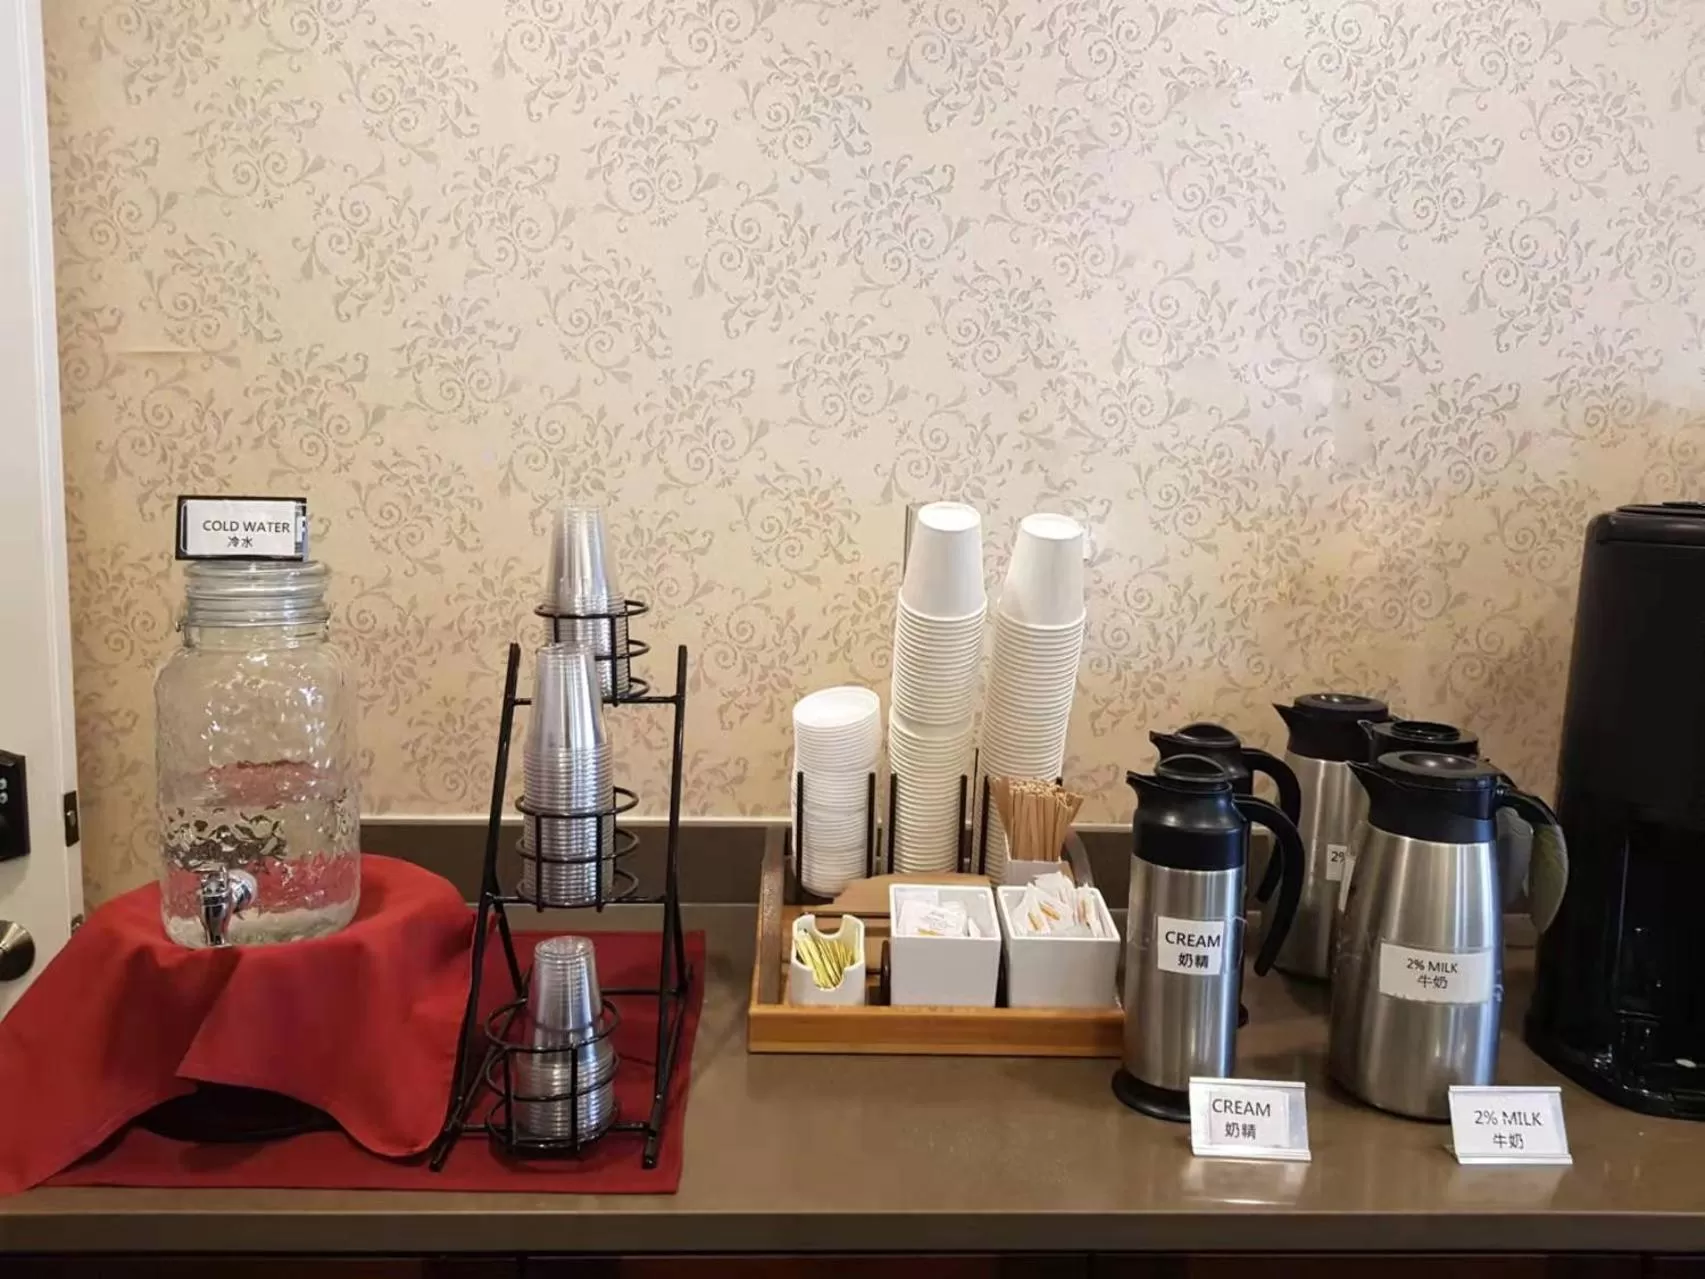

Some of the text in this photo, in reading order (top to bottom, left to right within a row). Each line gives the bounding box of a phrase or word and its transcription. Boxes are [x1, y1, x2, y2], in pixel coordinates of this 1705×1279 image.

[203, 520, 290, 533] COLD WATER
[227, 536, 253, 548] 冷水
[1165, 931, 1221, 947] CREAM
[1177, 953, 1208, 968] 奶精
[1406, 958, 1458, 973] 2% MILK
[1417, 974, 1448, 989] 牛奶
[1212, 1098, 1271, 1117] CREAM
[1474, 1110, 1543, 1126] 2% MILK
[1225, 1122, 1256, 1139] 奶精
[1493, 1133, 1524, 1149] 牛奶
